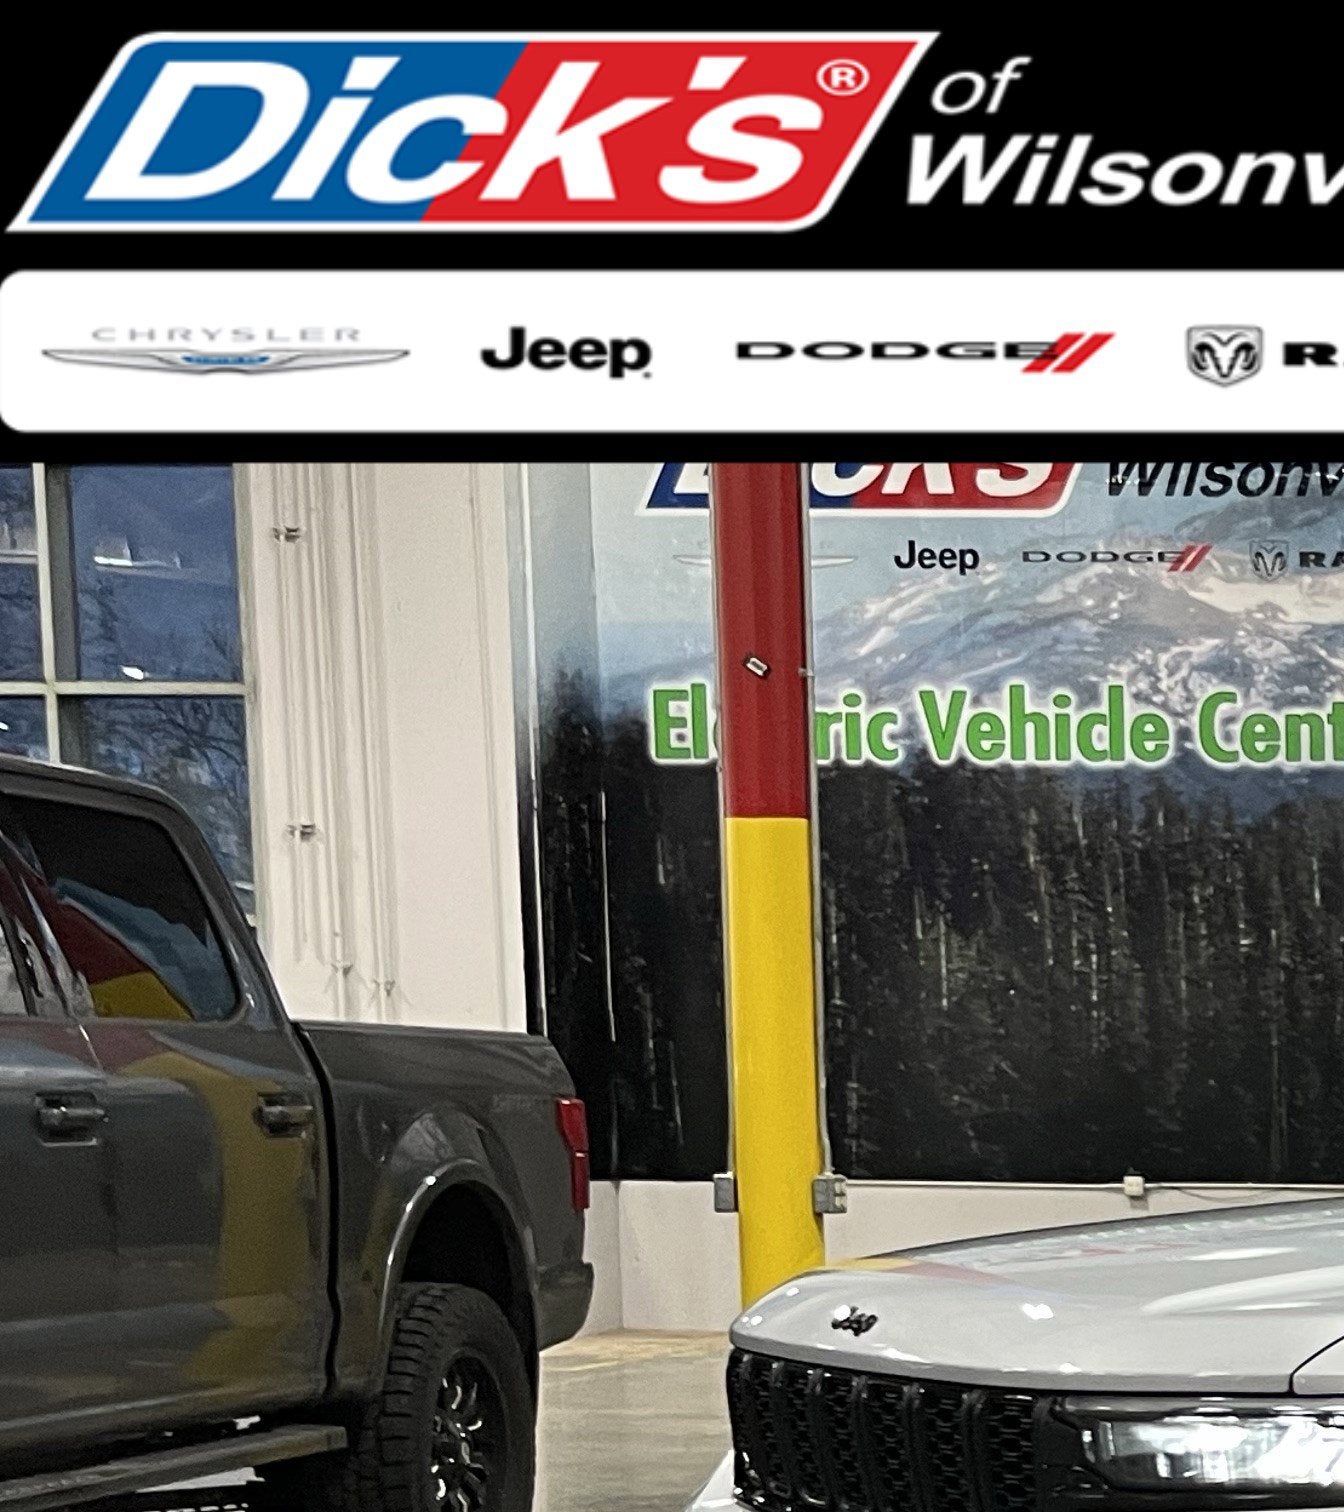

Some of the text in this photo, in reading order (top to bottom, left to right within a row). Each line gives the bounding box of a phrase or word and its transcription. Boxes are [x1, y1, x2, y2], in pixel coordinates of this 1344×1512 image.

[893, 539, 980, 576] Jeep
[1022, 550, 1180, 564] DODGE
[653, 683, 899, 761] Elric
[919, 684, 1168, 761] Vehicle
